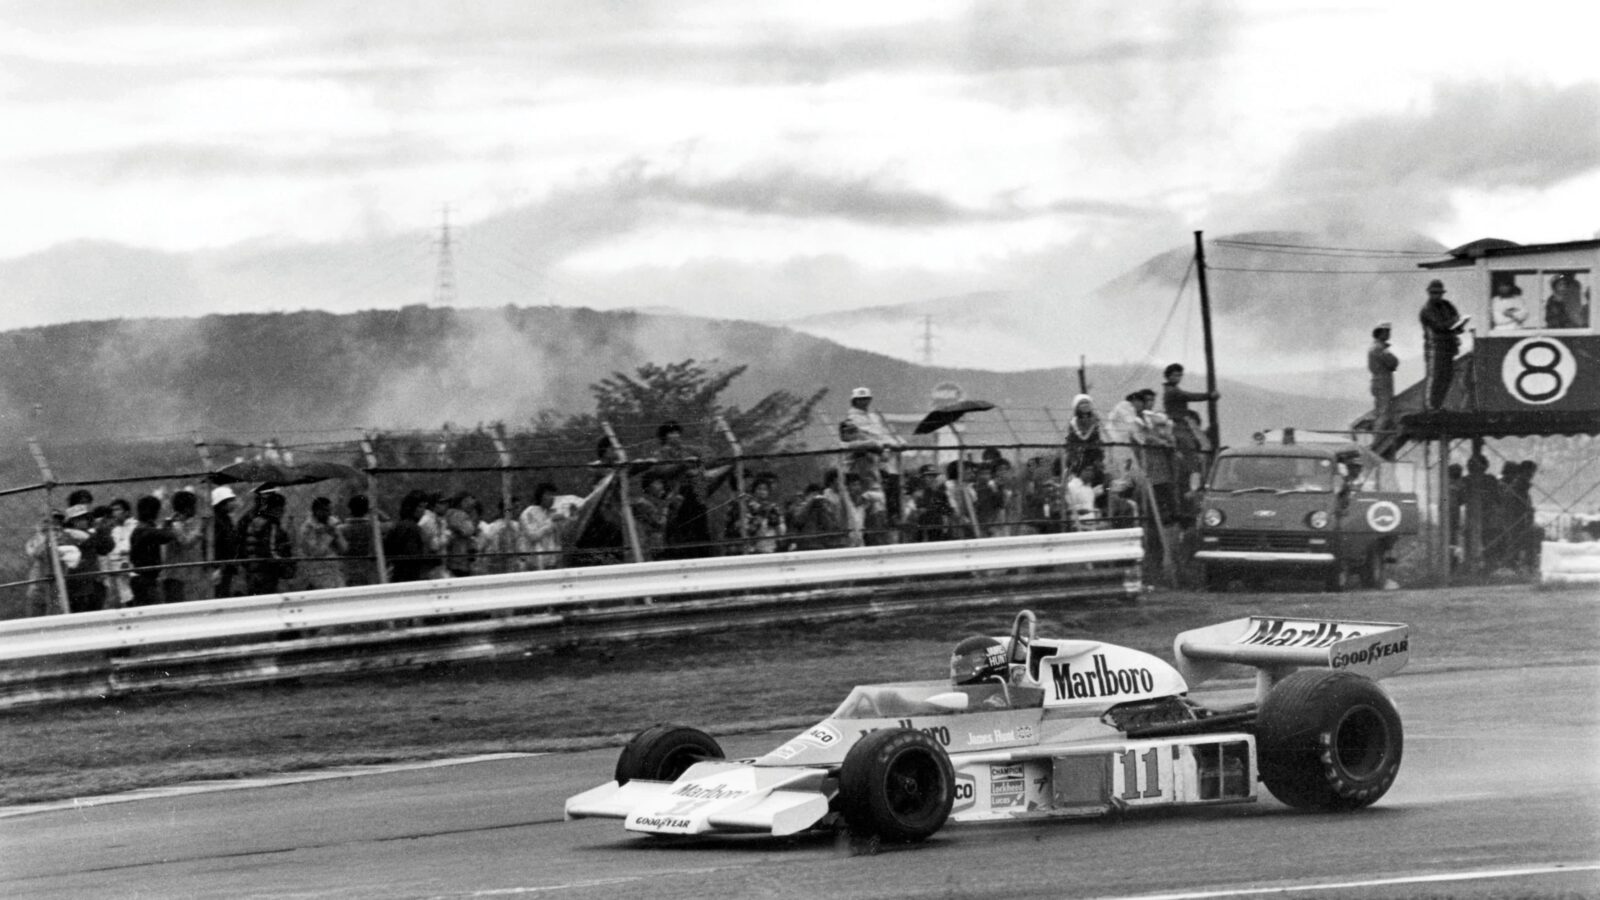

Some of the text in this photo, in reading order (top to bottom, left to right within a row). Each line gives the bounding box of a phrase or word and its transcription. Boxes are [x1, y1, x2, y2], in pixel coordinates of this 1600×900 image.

[1516, 341, 1563, 401] 8
[988, 653, 1007, 667] HUNT
[1051, 654, 1154, 700] Marlboro
[1120, 747, 1162, 800] 11
[635, 816, 691, 829] GOODYEAR
